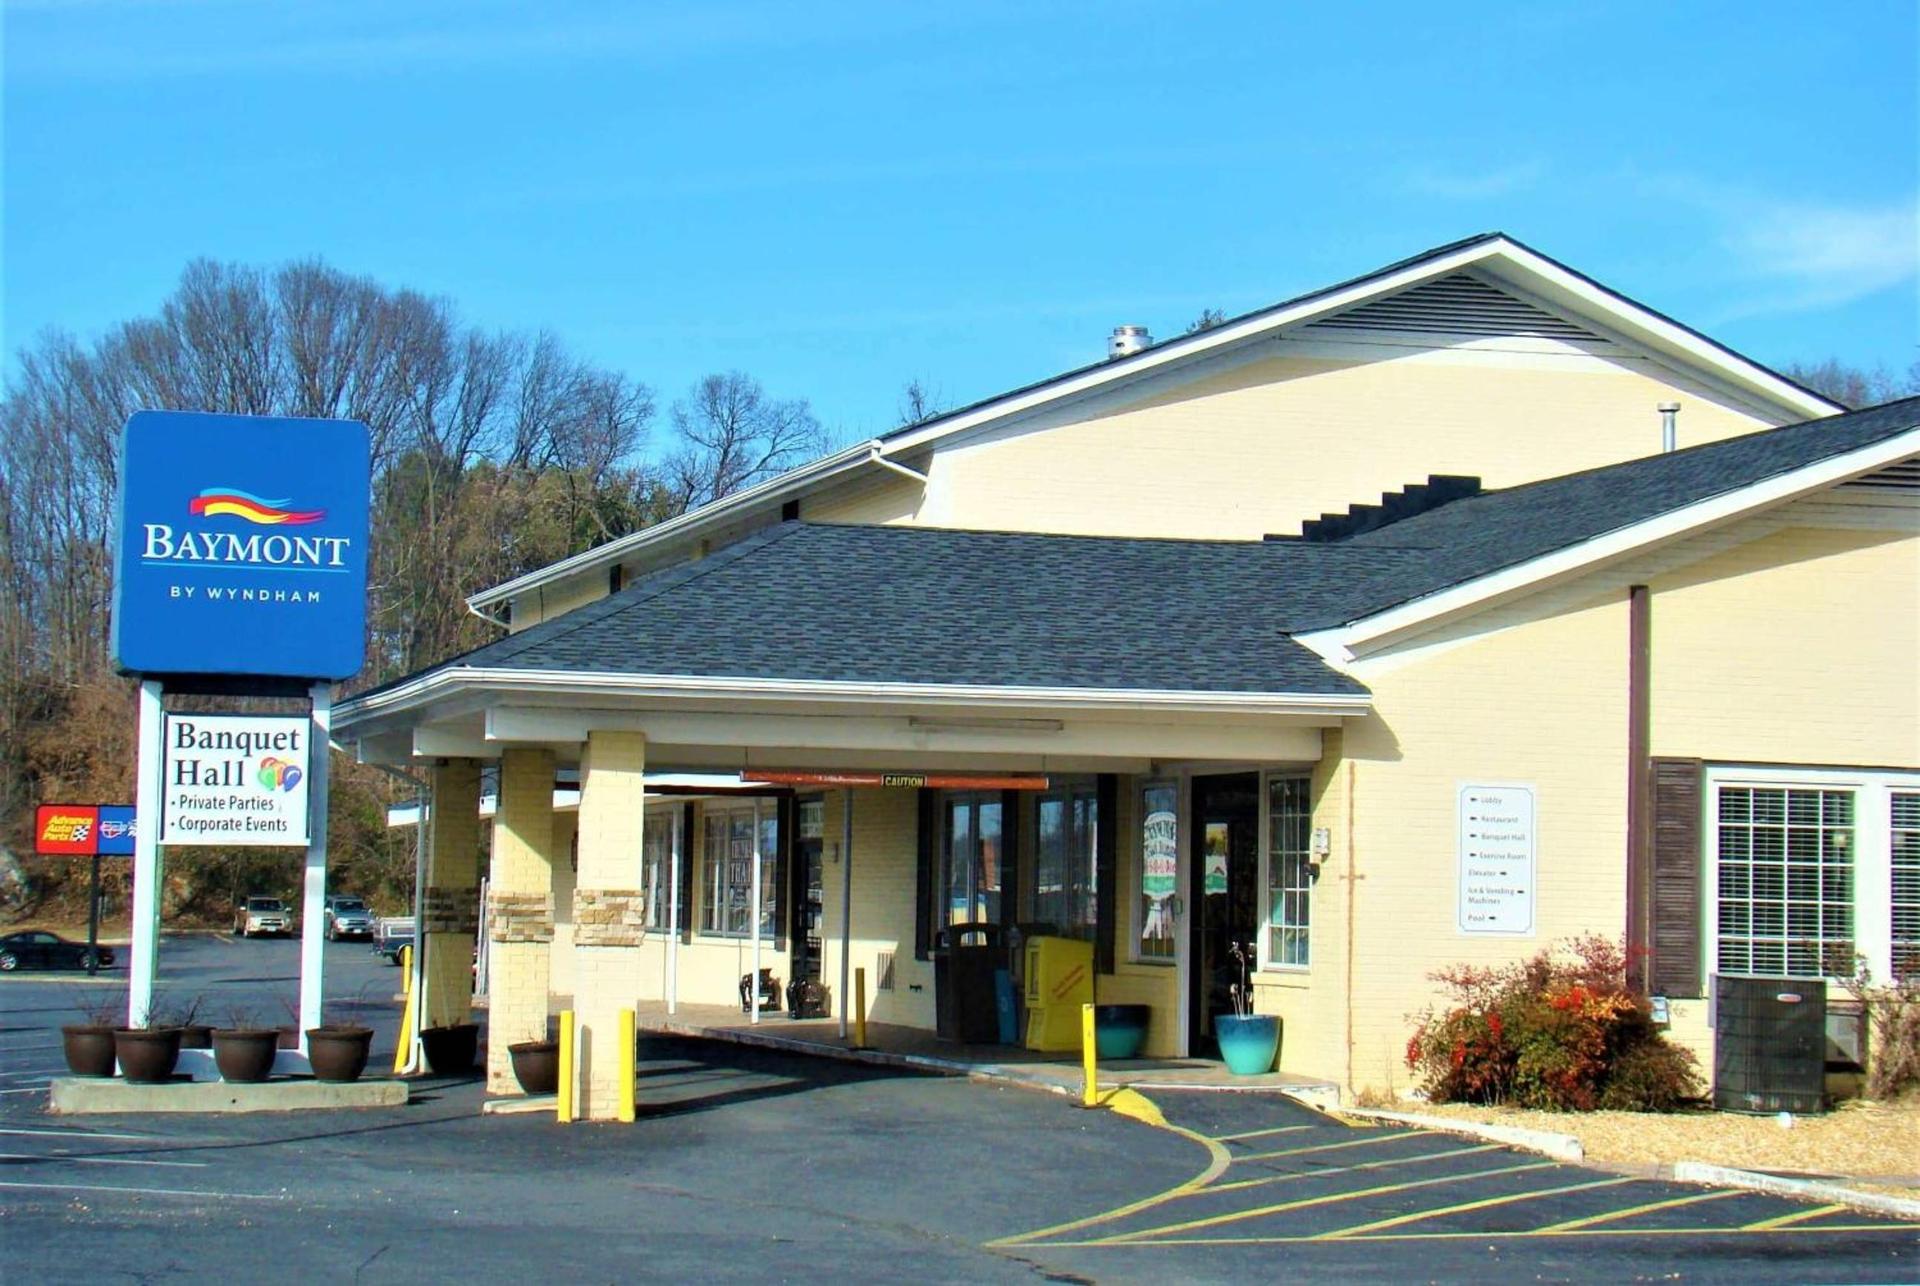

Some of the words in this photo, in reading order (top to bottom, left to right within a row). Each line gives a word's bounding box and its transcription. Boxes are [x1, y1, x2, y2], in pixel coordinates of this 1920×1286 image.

[142, 524, 349, 566] BAYMONT
[170, 586, 195, 598] BY
[207, 588, 320, 603] WYNDHAM
[174, 722, 300, 757] Banquet
[174, 760, 244, 786] Hall
[885, 776, 923, 787] CAUTION
[179, 795, 225, 810] Private
[229, 795, 274, 811] Parties
[178, 816, 242, 834] Corporate
[246, 817, 288, 832] Events
